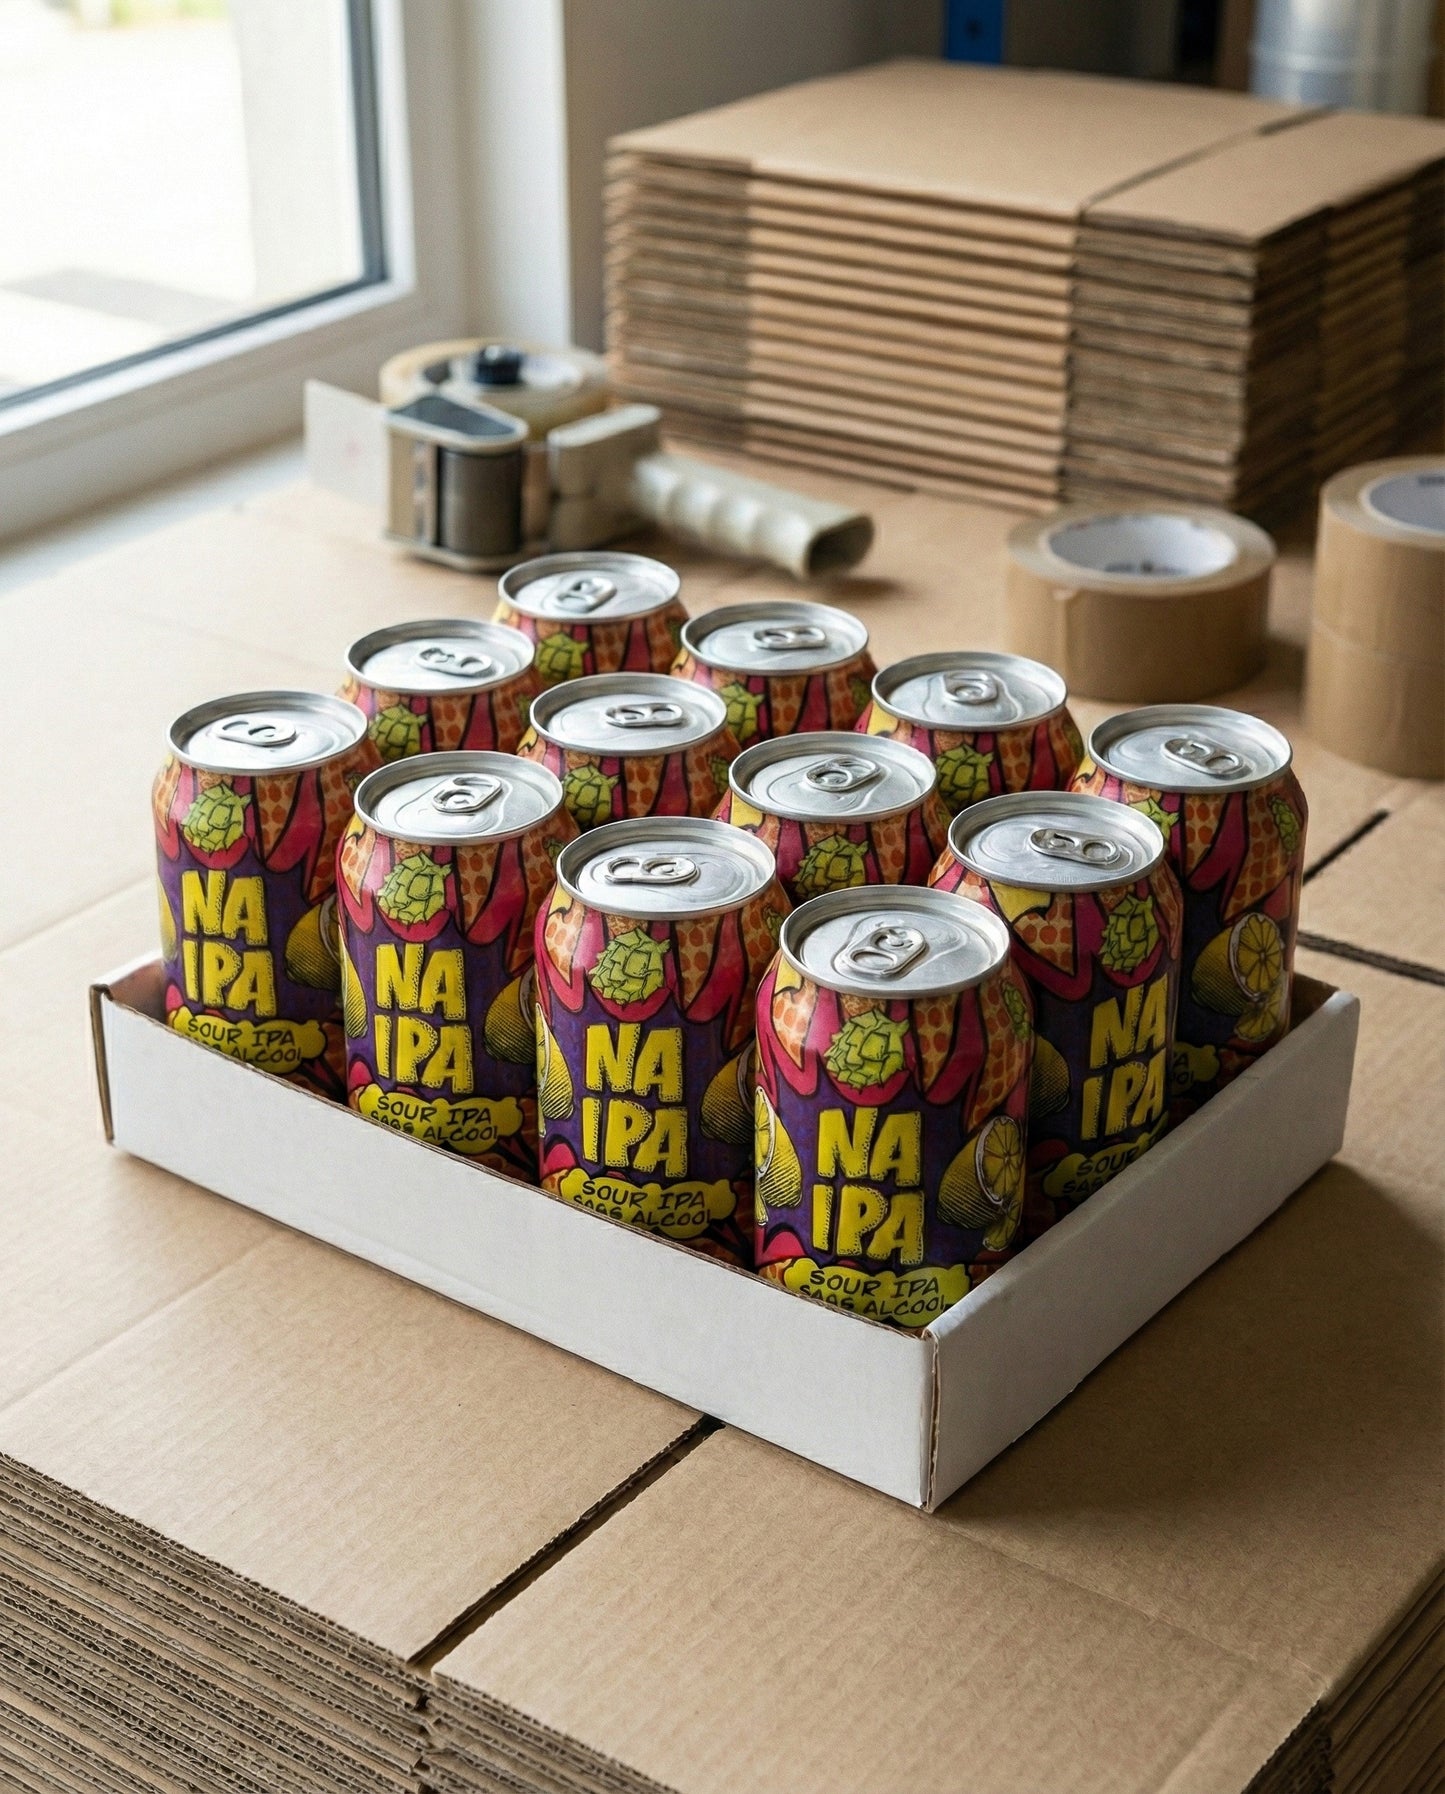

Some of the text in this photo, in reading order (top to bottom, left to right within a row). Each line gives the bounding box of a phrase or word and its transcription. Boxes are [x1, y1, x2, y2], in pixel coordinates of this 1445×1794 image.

[181, 869, 269, 946] NA
[181, 938, 277, 1018] IPA
[375, 943, 467, 1021] NA
[187, 1015, 243, 1044] SOUR
[252, 1029, 296, 1047] IPA
[373, 1014, 474, 1095] IPA
[1089, 972, 1169, 1070] NA
[585, 1023, 684, 1103] NA
[1081, 1047, 1167, 1142] IPA
[376, 1095, 492, 1126] SOUR IPA
[582, 1097, 689, 1179] IPA
[817, 1107, 922, 1187] NA
[582, 1180, 706, 1210] SOUR IPA
[812, 1184, 926, 1266] IPA
[809, 1270, 939, 1299] SOUR IPA
